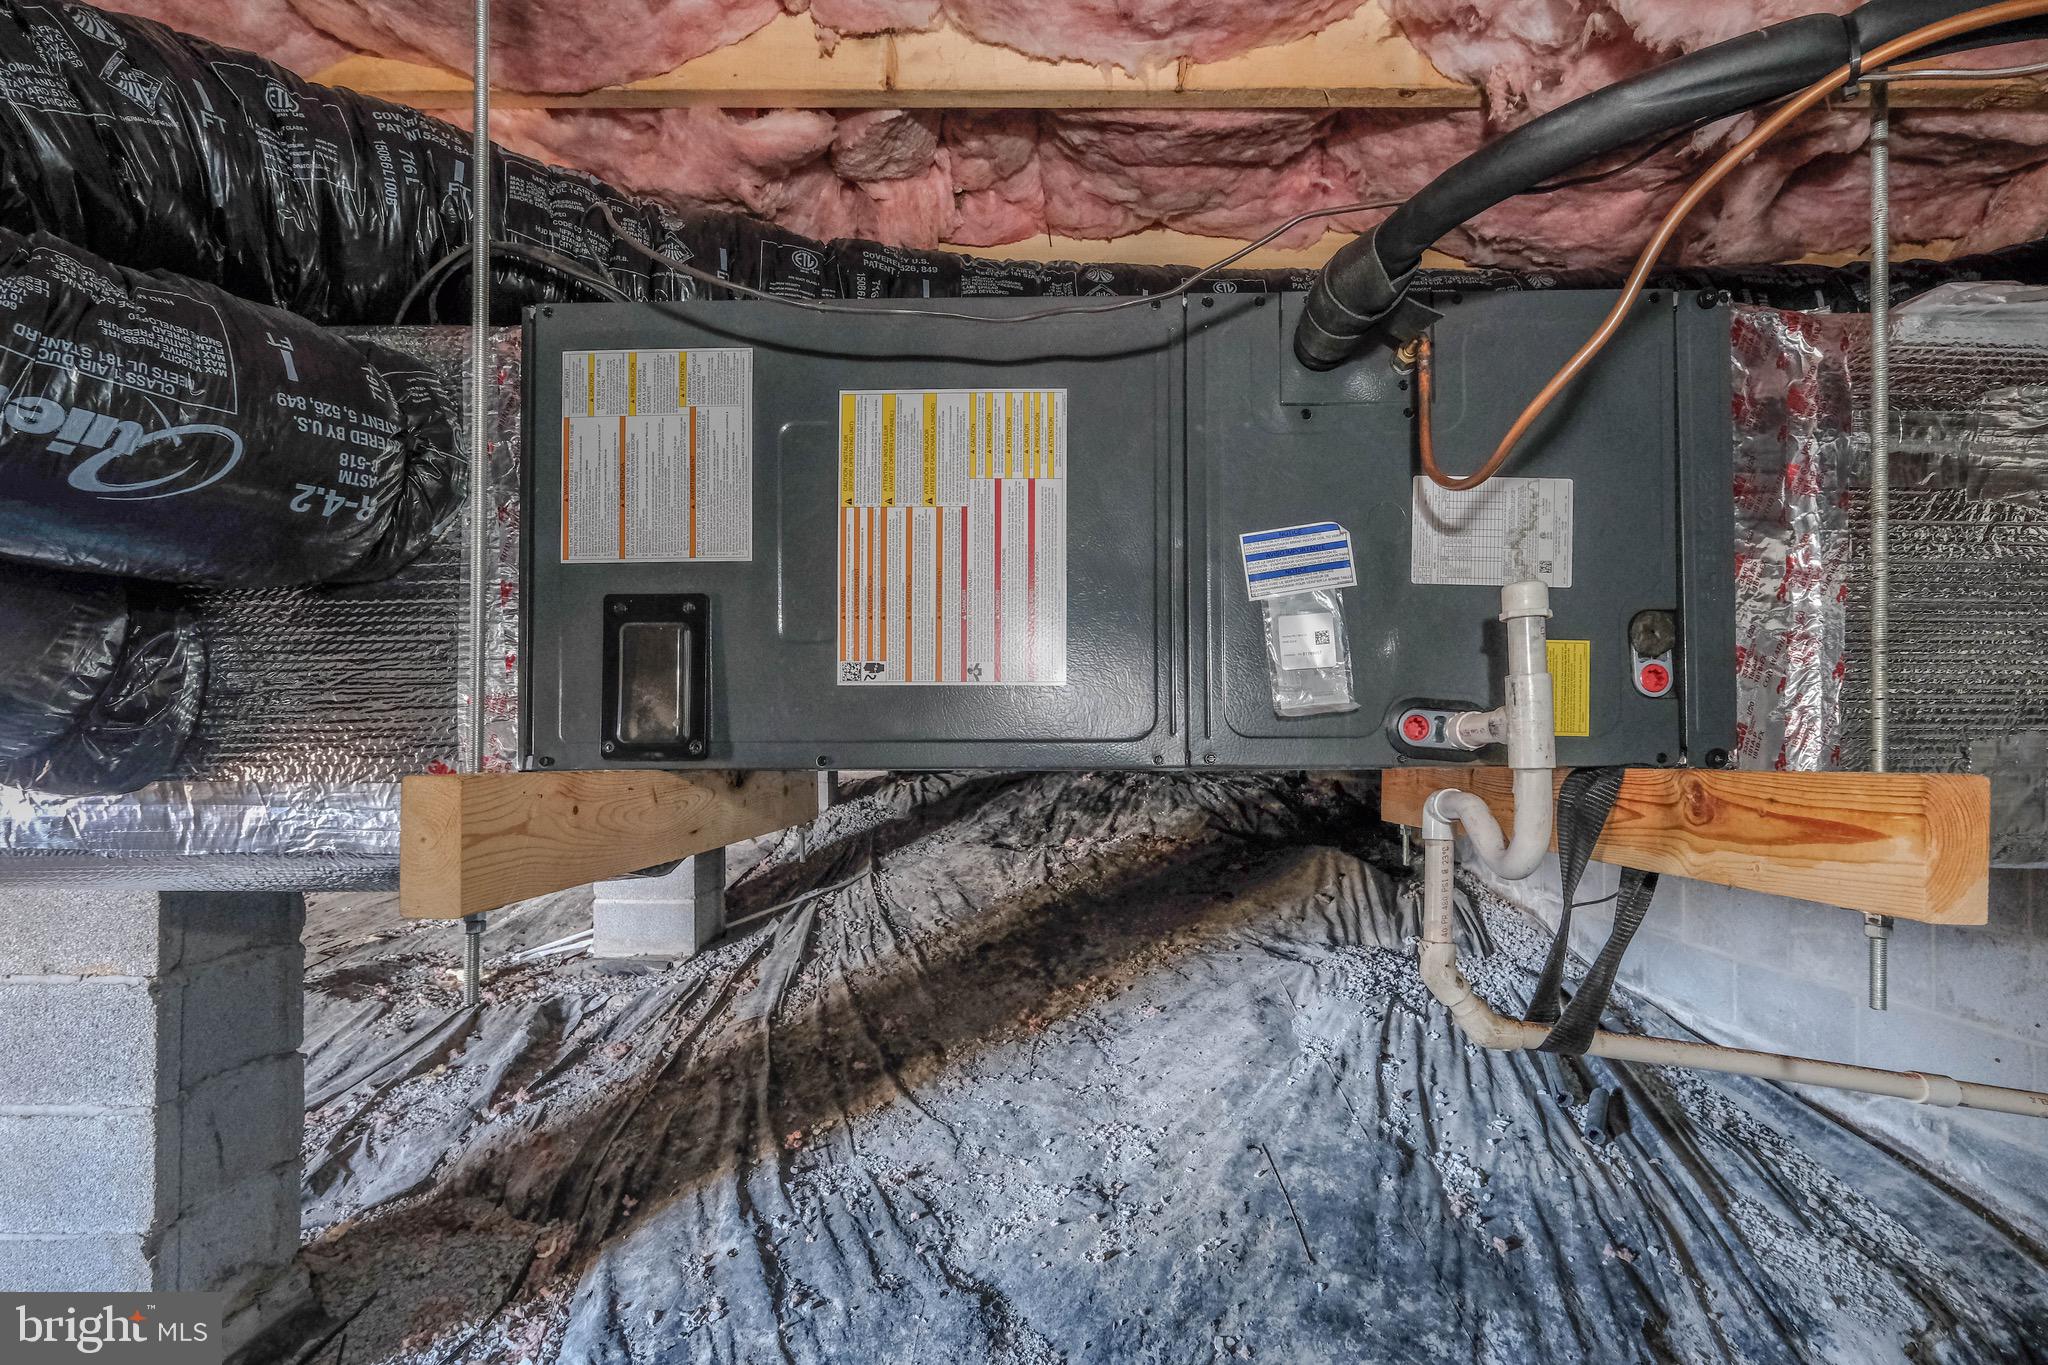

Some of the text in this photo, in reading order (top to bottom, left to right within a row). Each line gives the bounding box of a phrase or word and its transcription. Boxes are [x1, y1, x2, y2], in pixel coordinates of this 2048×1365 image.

[862, 251, 902, 267] COVERE
[864, 258, 896, 275] PATENT
[920, 265, 938, 274] 849
[101, 327, 160, 351] PRESSRE
[128, 313, 223, 348] SMOK DEVELOPD
[152, 326, 225, 355] FLAM SPREAD
[157, 335, 200, 356] NGATIVE
[163, 345, 200, 366] PSITIVE
[37, 348, 176, 396] CLASS AIR DUC
[127, 359, 148, 376] UL
[160, 352, 228, 378] MAX VLOCITY
[276, 392, 307, 409] 849
[308, 397, 341, 419] 526,
[343, 405, 358, 423] 5,
[293, 415, 324, 435] U.S.
[326, 422, 347, 443] BY
[0, 396, 243, 501] Quie
[338, 452, 378, 473] -518
[338, 469, 378, 490] ASTM
